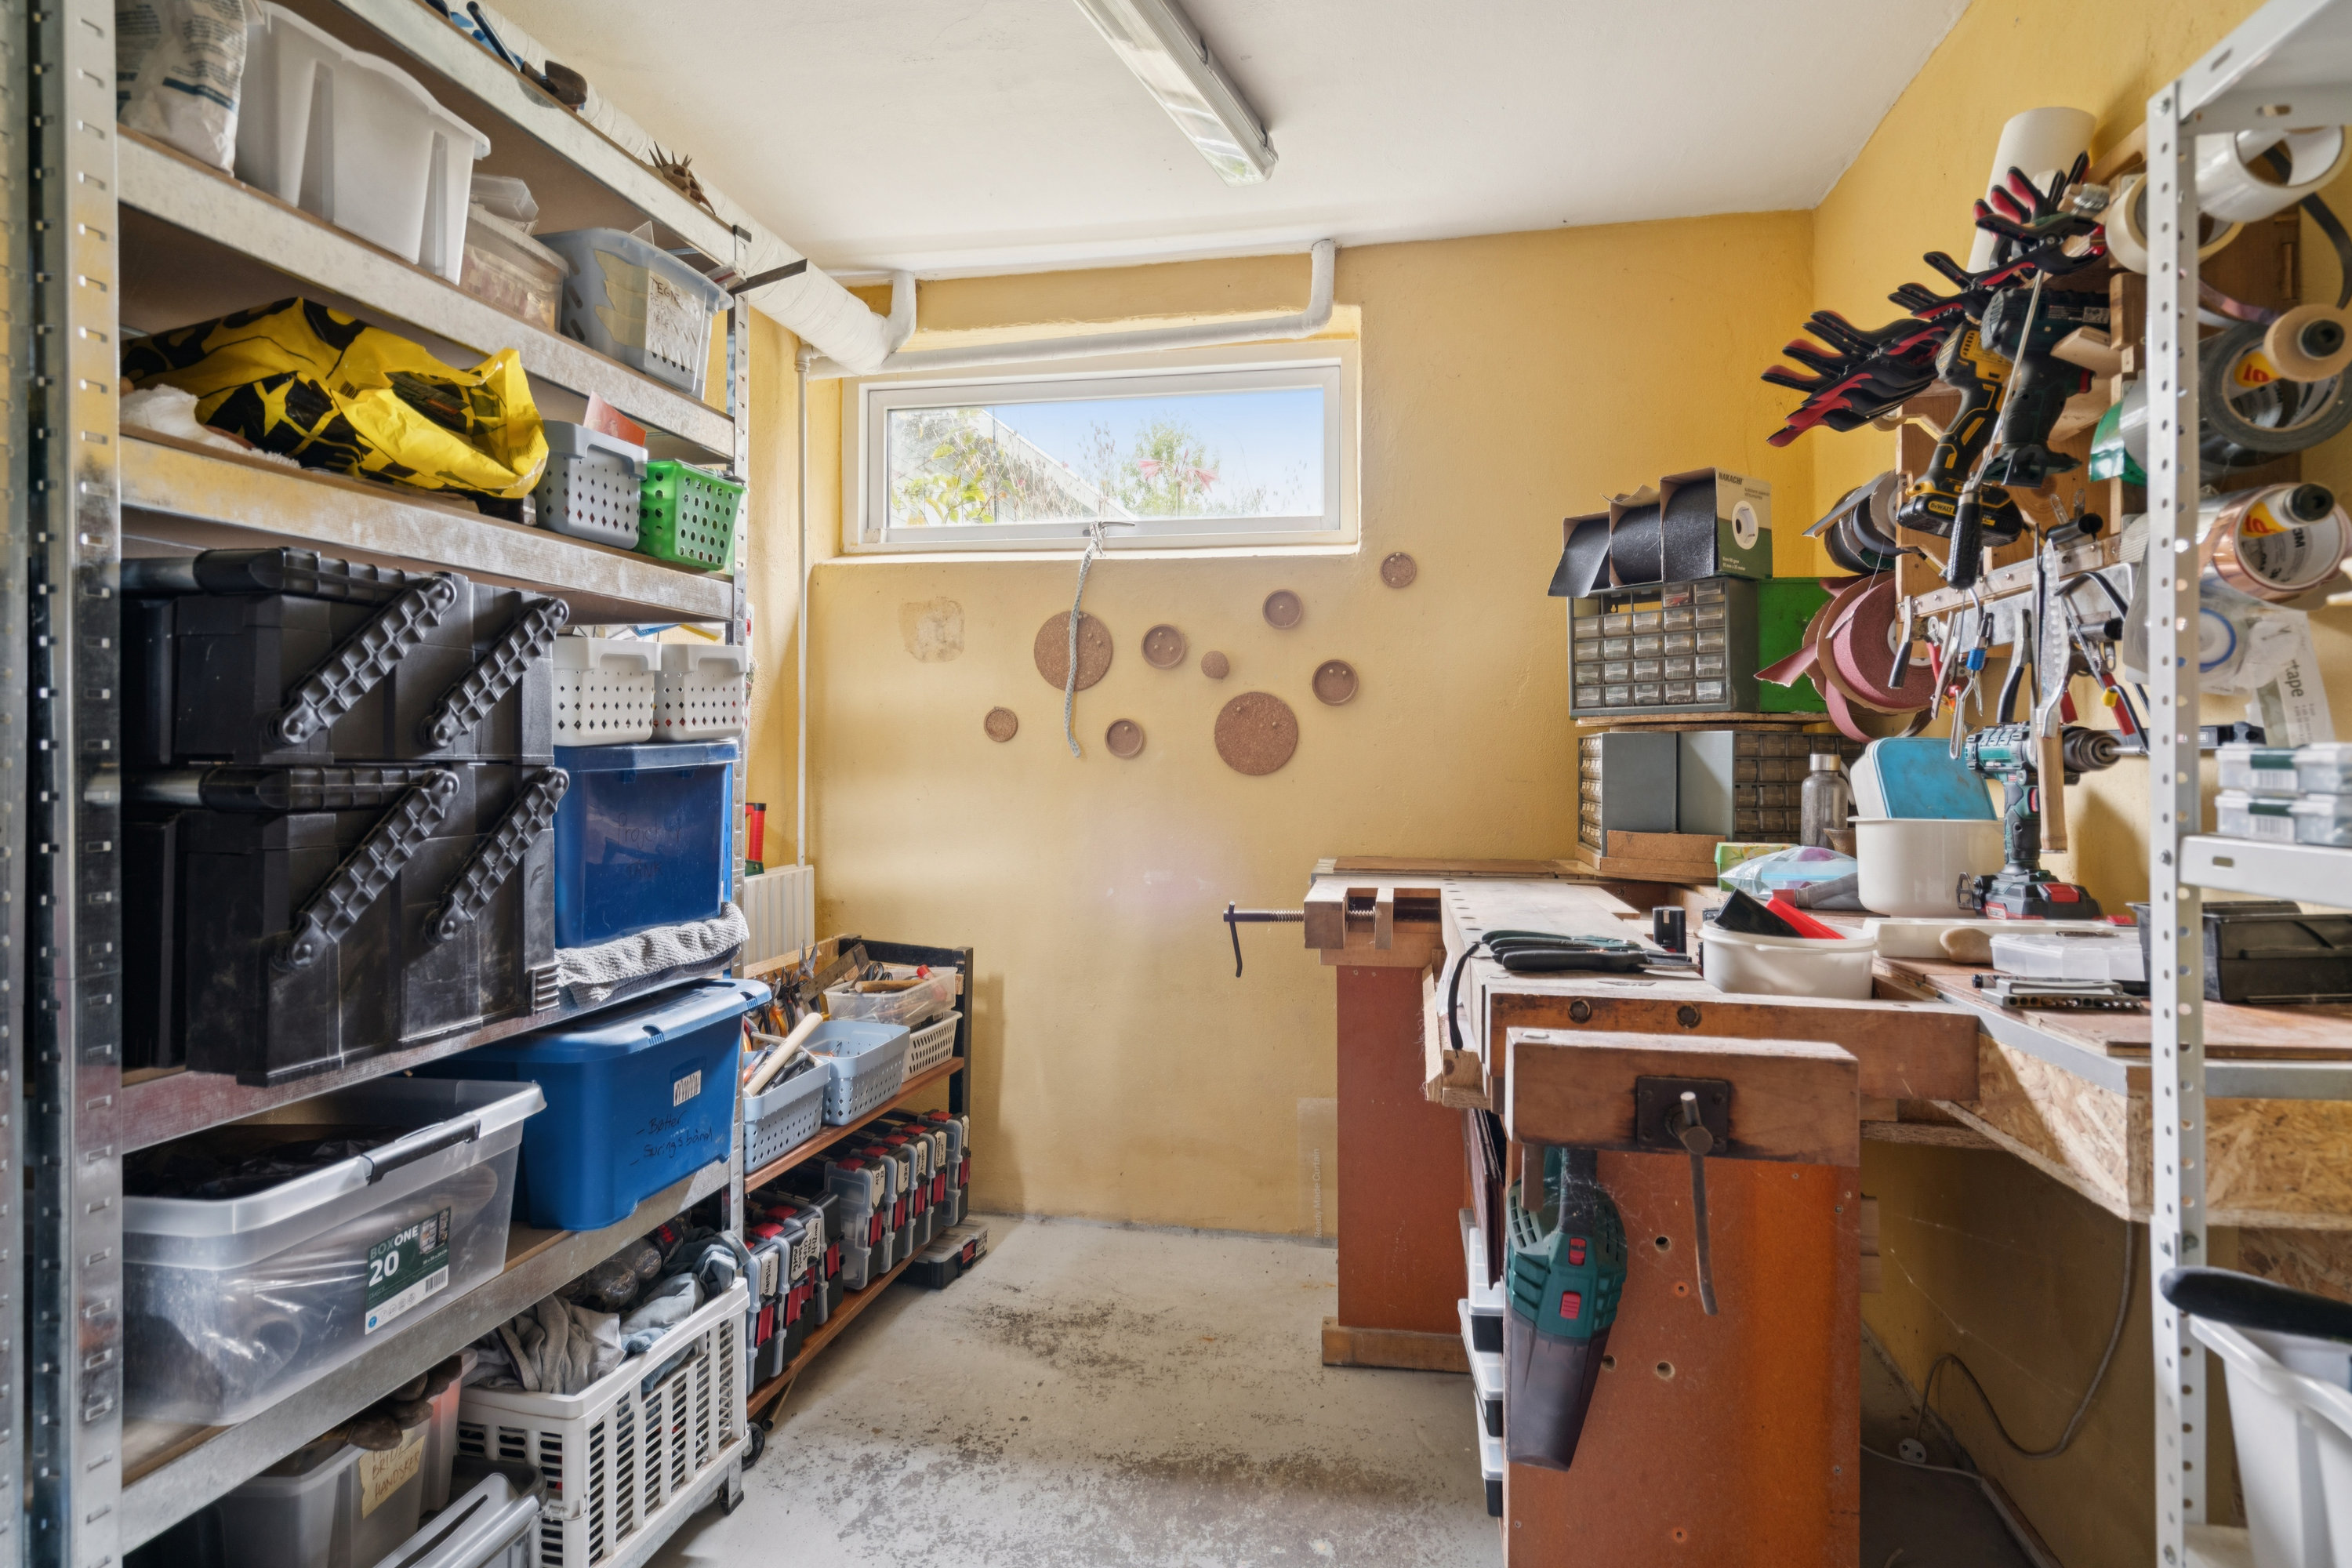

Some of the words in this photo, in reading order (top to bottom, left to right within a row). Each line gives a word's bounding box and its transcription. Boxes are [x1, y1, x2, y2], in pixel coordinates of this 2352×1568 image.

[1719, 472, 1742, 485] NAKACHI
[2292, 528, 2305, 548] 3M
[368, 1250, 400, 1287] 20
